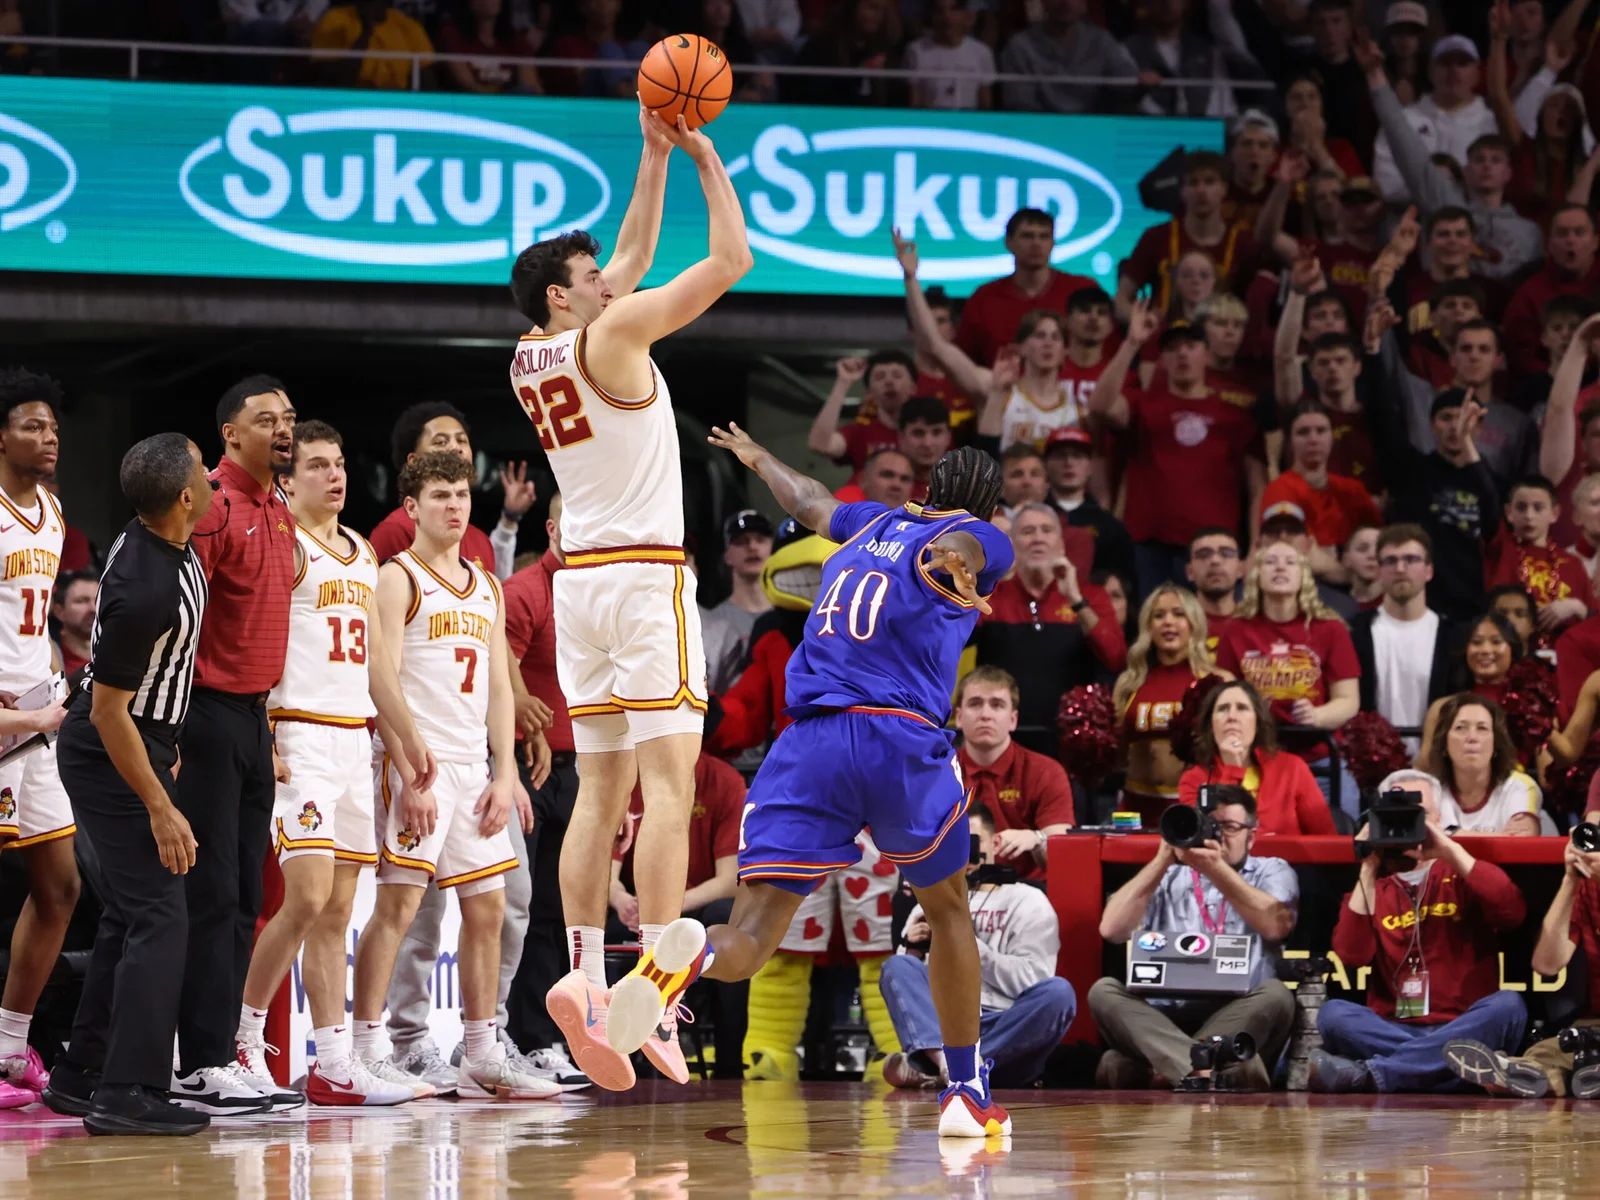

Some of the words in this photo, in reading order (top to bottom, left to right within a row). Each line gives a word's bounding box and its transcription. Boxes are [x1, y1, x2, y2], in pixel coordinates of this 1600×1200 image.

[222, 105, 567, 256] Sukup
[518, 374, 596, 453] 22
[3, 548, 33, 581] IOWA
[33, 547, 60, 580] STAT
[18, 588, 49, 637] 11
[316, 578, 346, 610] IOWA
[346, 579, 375, 615] STAT
[815, 567, 890, 643] 40
[326, 616, 367, 666] 13
[428, 610, 460, 641] IOWA
[454, 647, 478, 694] 7
[1136, 701, 1183, 732] IS
[1219, 960, 1247, 970] MP
